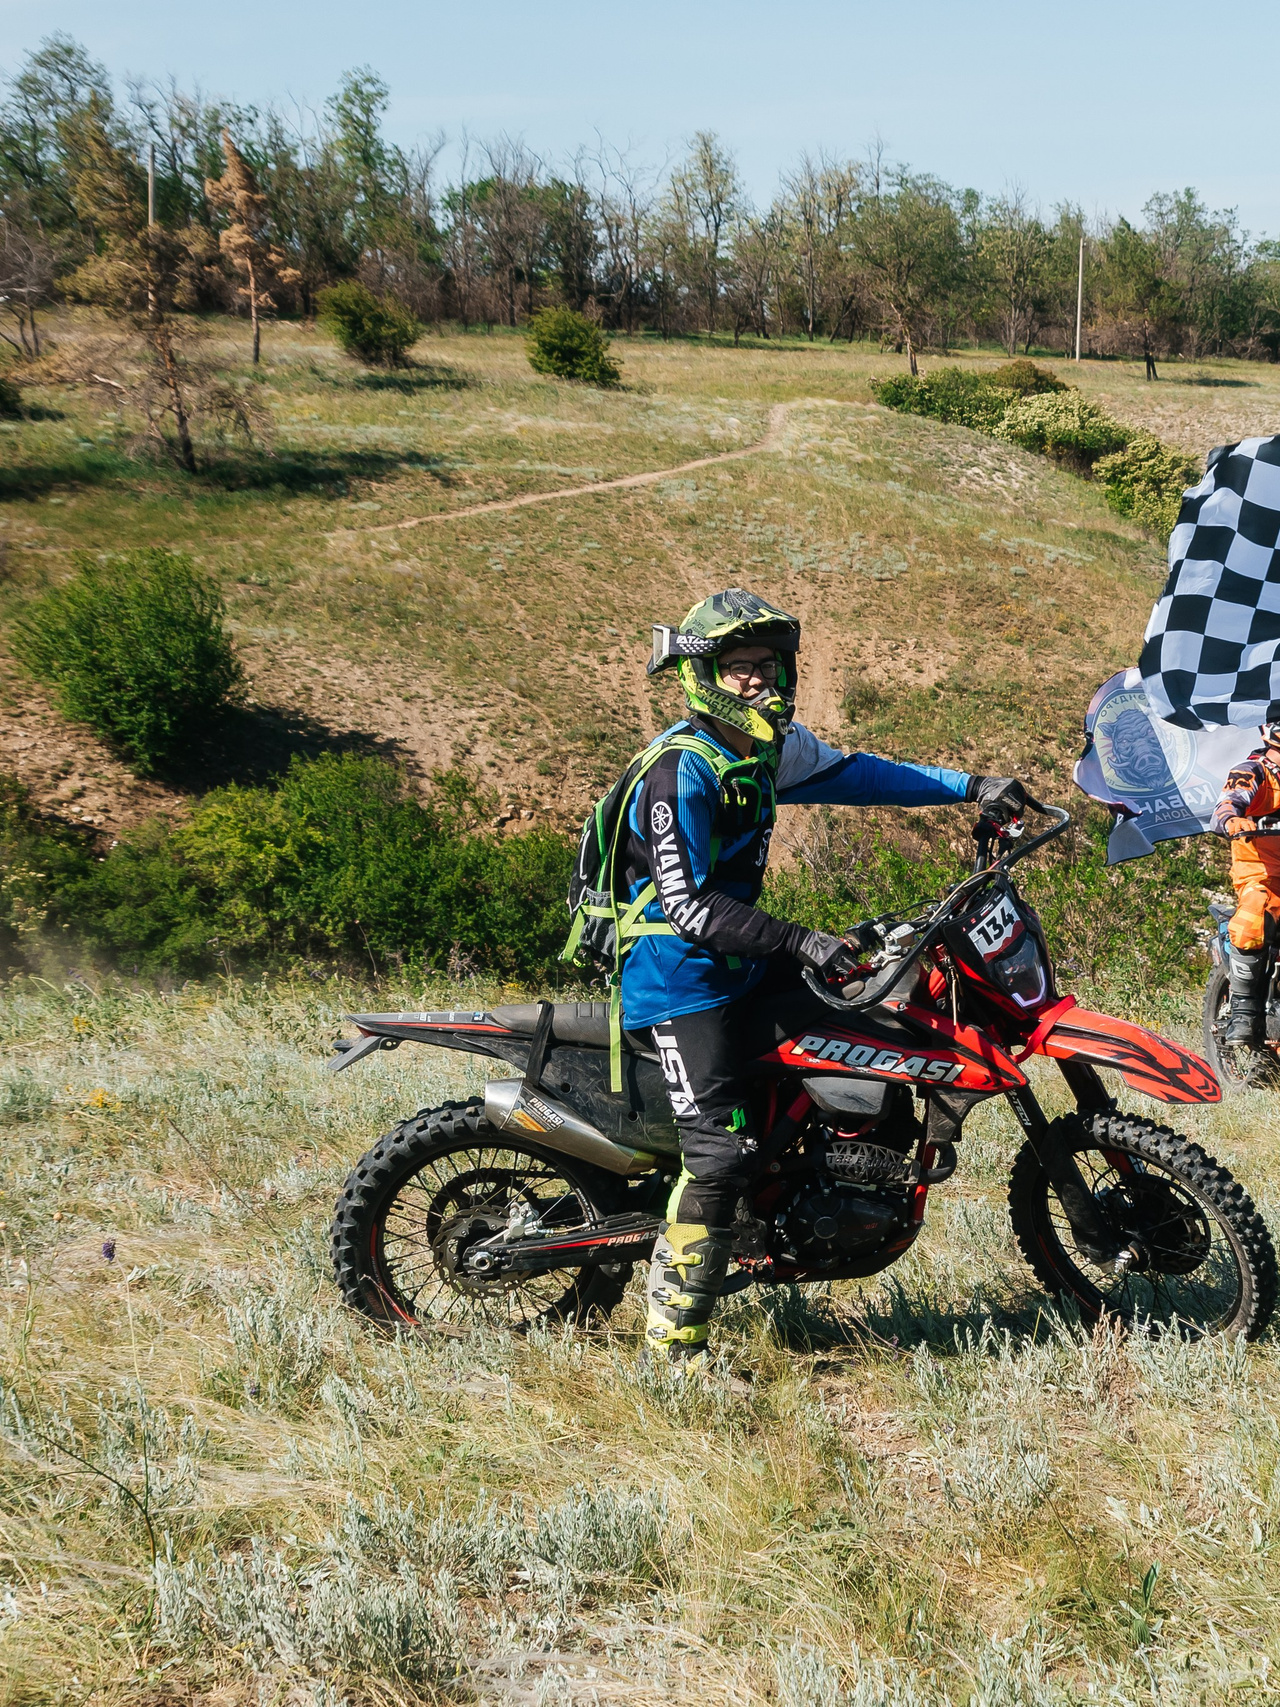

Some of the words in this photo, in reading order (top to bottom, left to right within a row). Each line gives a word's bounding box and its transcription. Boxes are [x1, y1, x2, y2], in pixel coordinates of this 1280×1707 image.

[657, 833, 710, 936] YAMAHA
[977, 906, 1015, 947] 134
[791, 1035, 966, 1083] PROGASI
[529, 1097, 564, 1126] PROGASI
